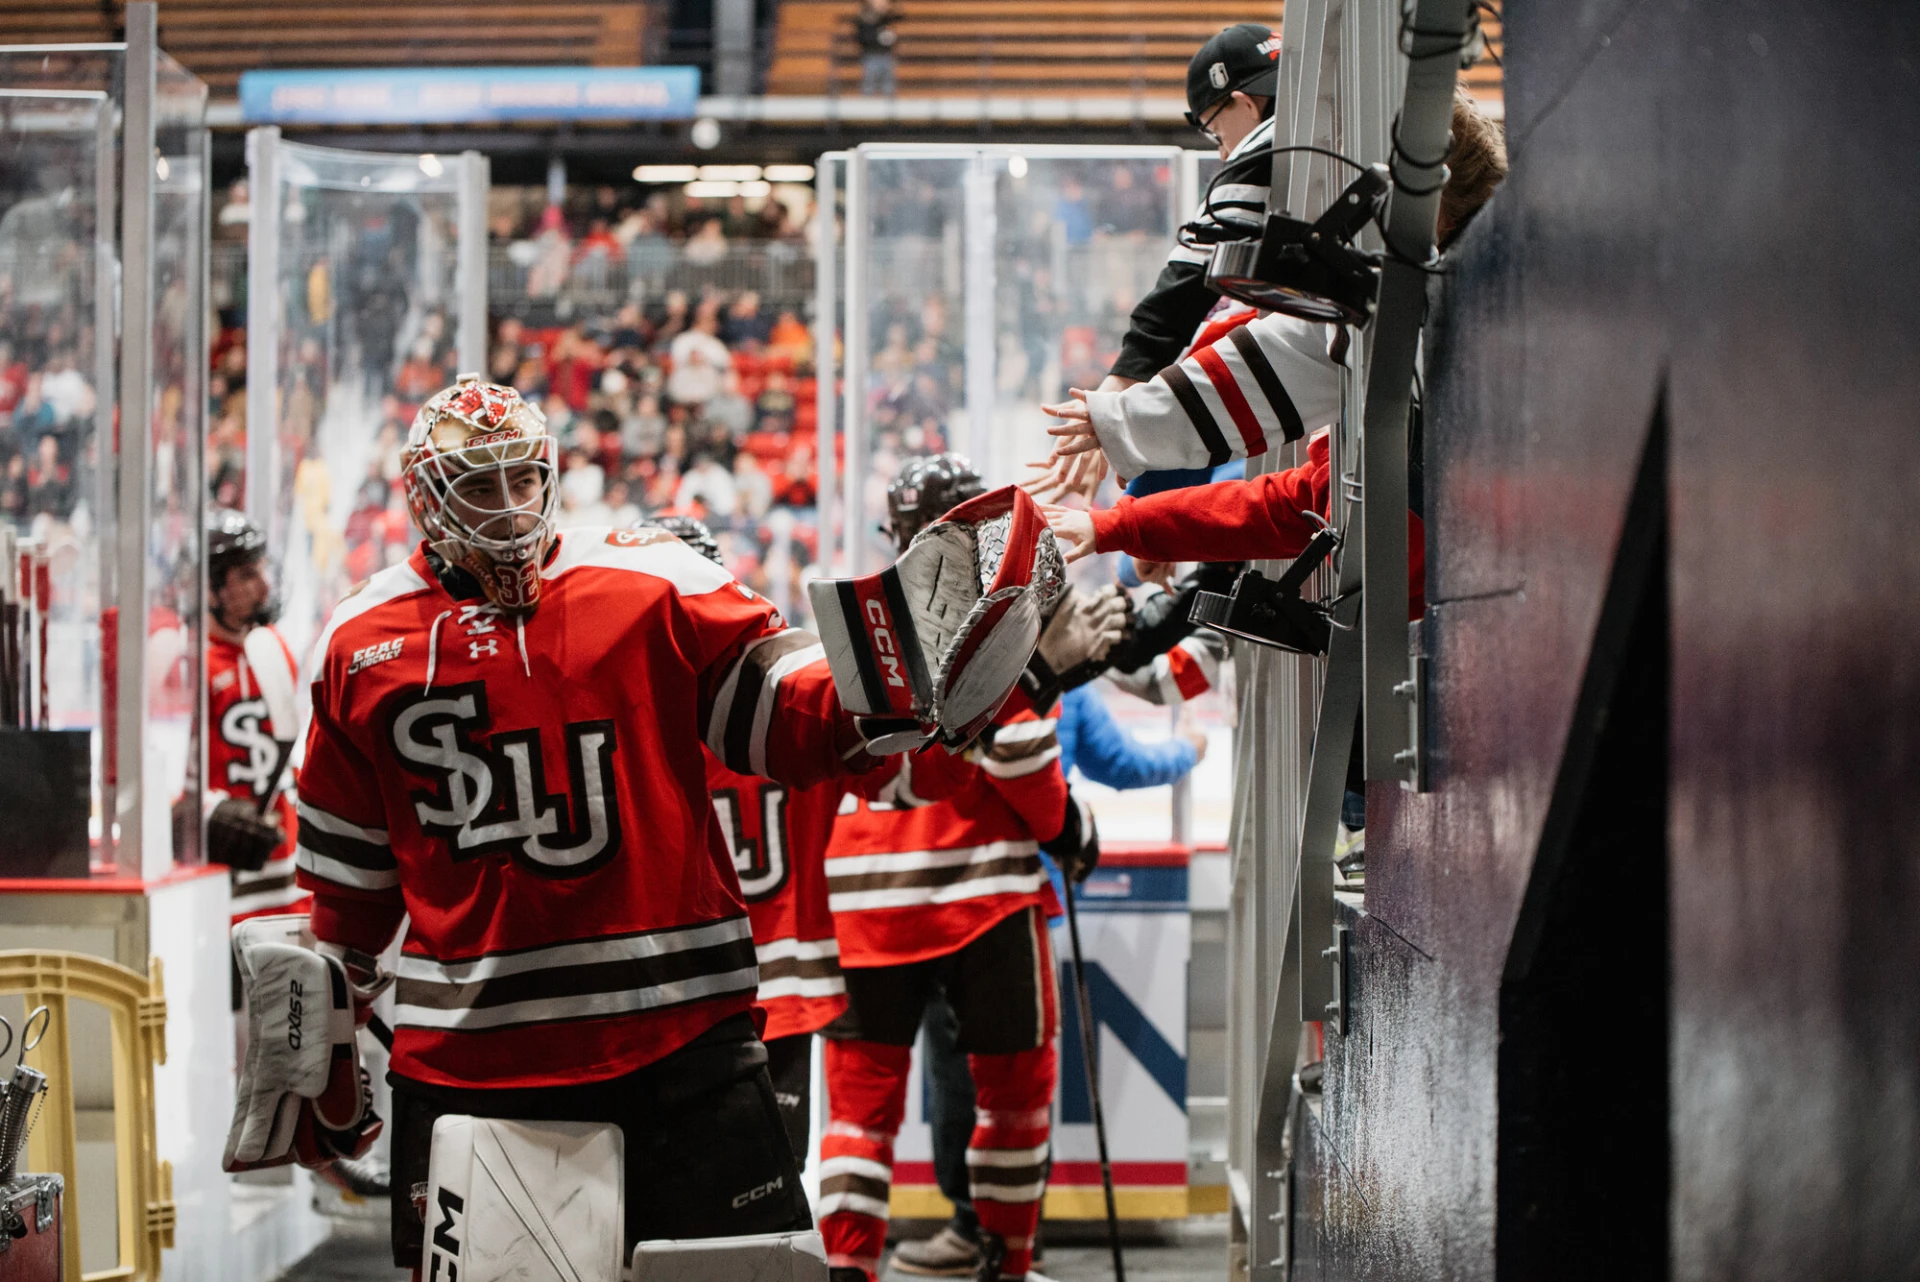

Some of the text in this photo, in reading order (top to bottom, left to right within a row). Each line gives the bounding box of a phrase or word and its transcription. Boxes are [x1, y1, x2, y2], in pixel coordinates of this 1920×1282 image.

[466, 428, 521, 448] CCM
[494, 561, 540, 608] 32
[352, 636, 406, 665] ECAC
[359, 648, 402, 670] HOCKEY
[865, 599, 905, 688] CCM
[731, 1175, 783, 1209] CCM
[429, 1185, 464, 1282] CM
